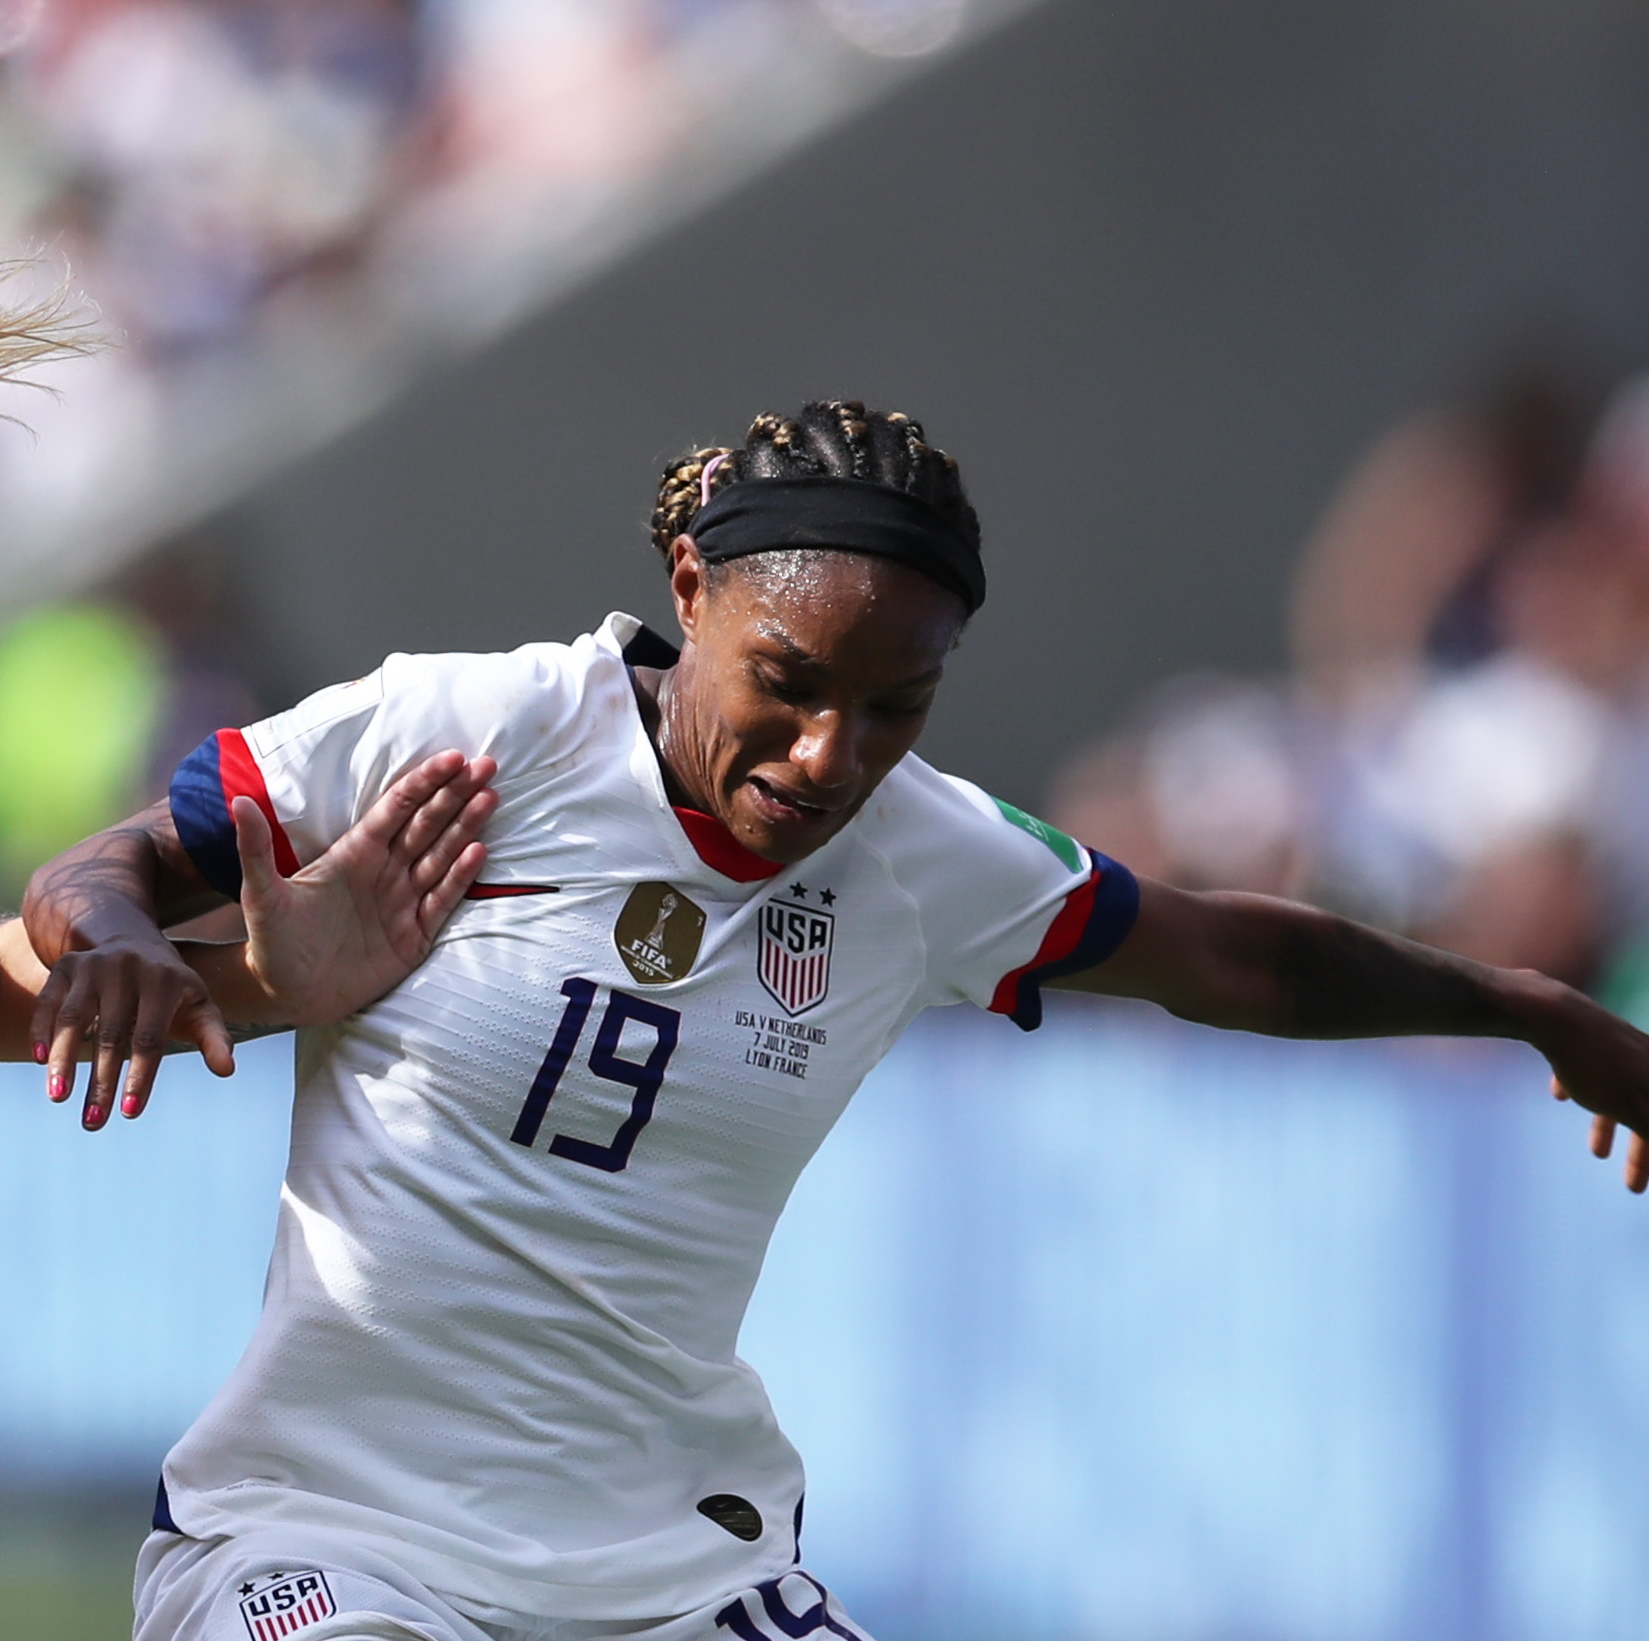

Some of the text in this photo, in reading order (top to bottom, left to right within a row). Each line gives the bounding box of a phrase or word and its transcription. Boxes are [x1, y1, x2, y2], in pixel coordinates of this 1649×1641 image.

[766, 905, 828, 954] USA
[631, 938, 667, 970] FIFA
[632, 959, 655, 977] 2015
[735, 1010, 827, 1046] USA V NETHERLANDS
[753, 1031, 809, 1060] 7 JULY 2019
[509, 976, 681, 1173] 19
[745, 1048, 808, 1080] LYON FRANCE
[248, 1576, 319, 1617] USA
